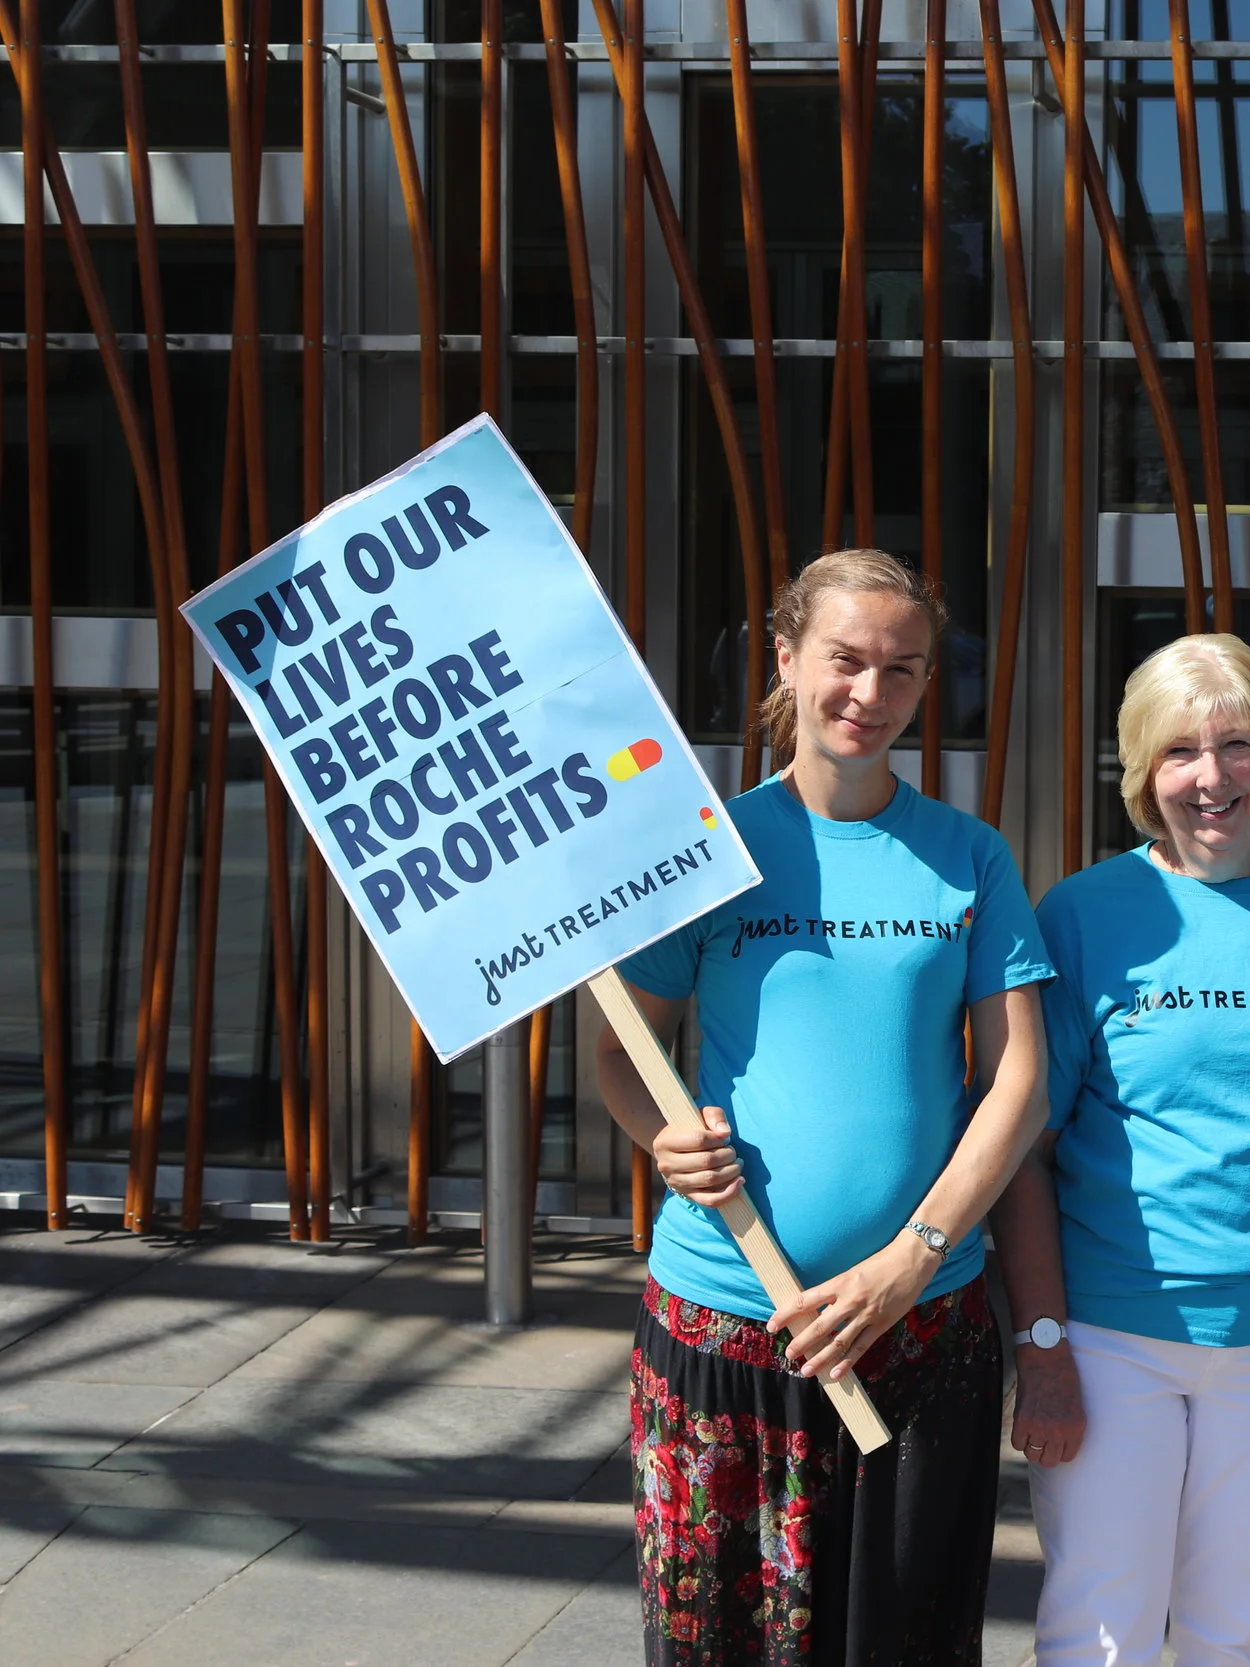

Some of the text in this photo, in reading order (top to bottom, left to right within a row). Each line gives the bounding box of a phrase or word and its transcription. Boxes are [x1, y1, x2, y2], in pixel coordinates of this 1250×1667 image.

[213, 484, 490, 674] PUT OUR
[256, 603, 414, 740] LIVES
[290, 628, 524, 805] BEFORE
[324, 711, 532, 871] ROCHE
[360, 752, 608, 936] PROFITS
[474, 838, 715, 1006] just TREATMENT
[731, 913, 963, 958] just TREATMENT
[1124, 986, 1194, 1028] just
